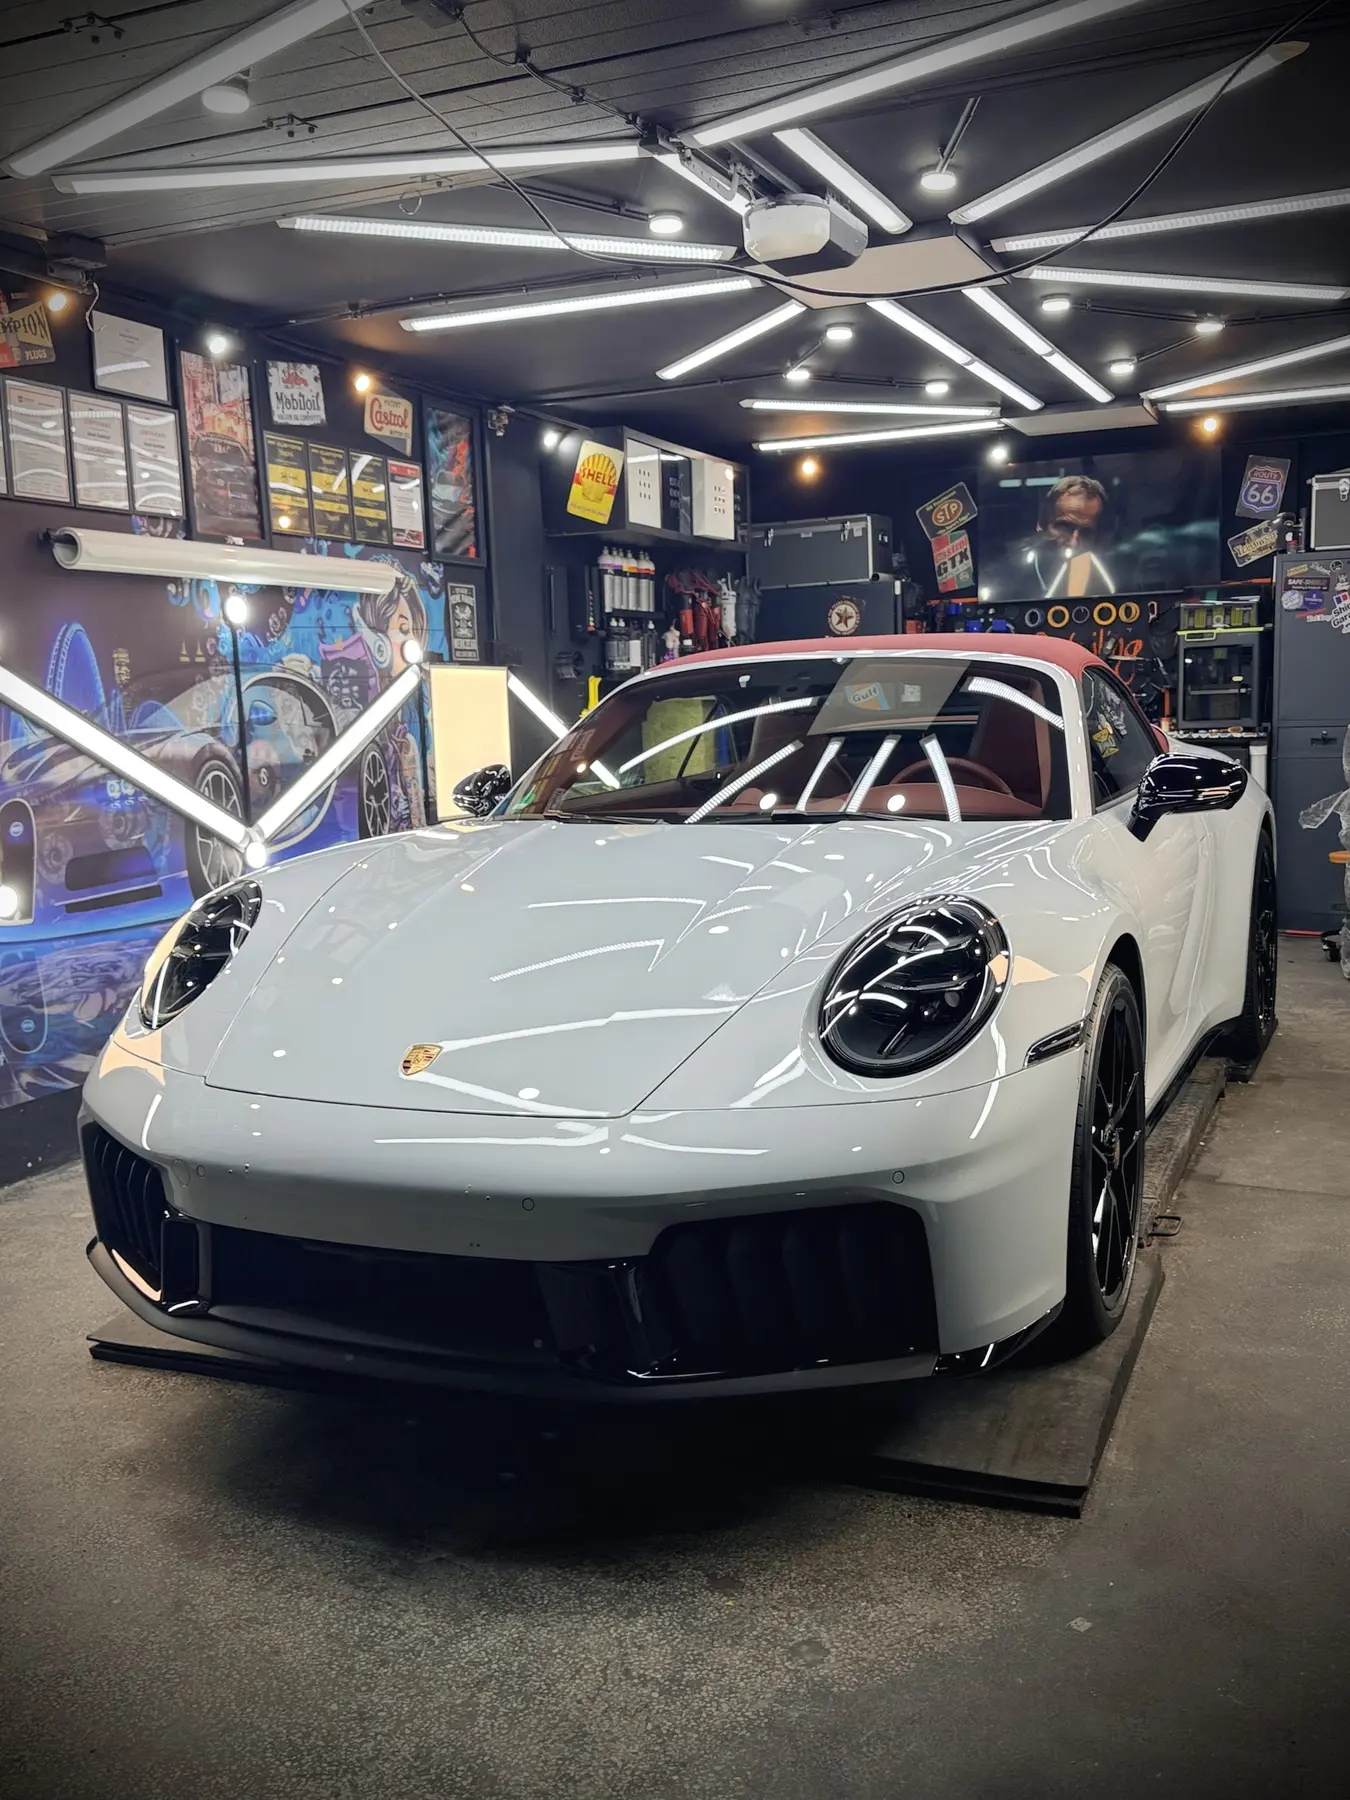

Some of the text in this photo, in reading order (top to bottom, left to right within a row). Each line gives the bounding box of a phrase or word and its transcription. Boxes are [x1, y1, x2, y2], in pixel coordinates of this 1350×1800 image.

[0, 305, 50, 342] MPION
[24, 349, 48, 361] PLUGS
[275, 391, 321, 412] Mobiloil
[369, 397, 409, 431] Castrol
[581, 468, 614, 487] SHELL
[1253, 470, 1280, 480] ROUTE
[1247, 483, 1274, 505] 66
[935, 502, 958, 523] STP
[934, 536, 968, 564] Castrol
[937, 547, 970, 578] GTX
[852, 686, 878, 702] Gulf
